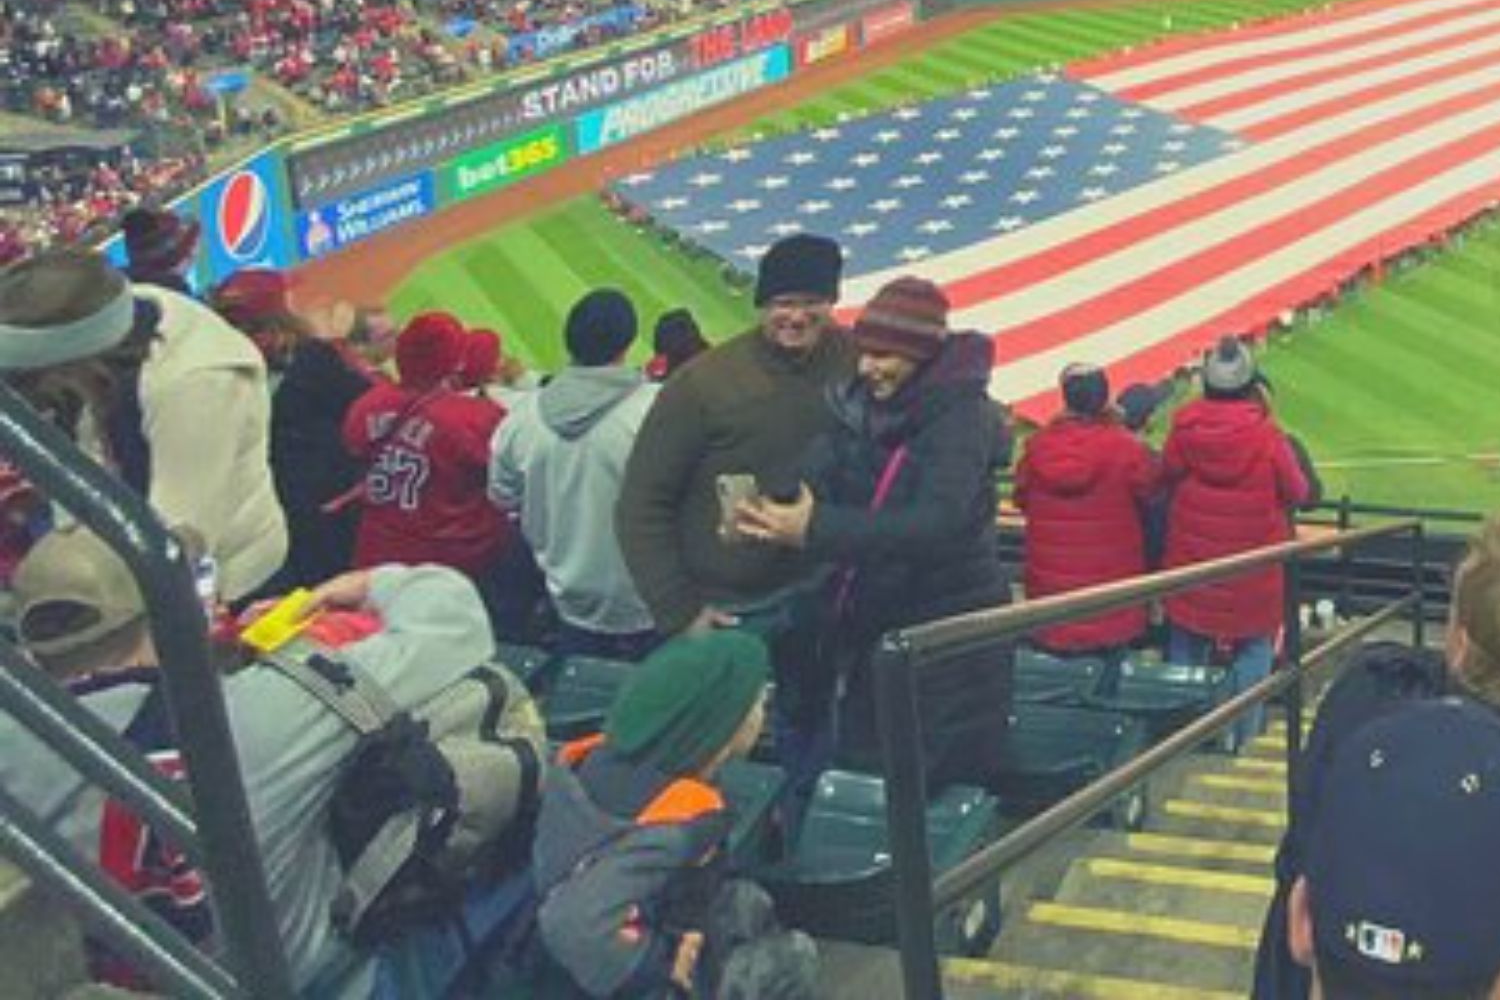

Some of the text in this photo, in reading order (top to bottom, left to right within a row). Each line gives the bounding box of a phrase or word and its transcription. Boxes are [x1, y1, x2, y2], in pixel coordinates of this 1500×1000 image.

[521, 65, 619, 121] STAND
[622, 48, 677, 91] FOR
[457, 134, 557, 190] bet365
